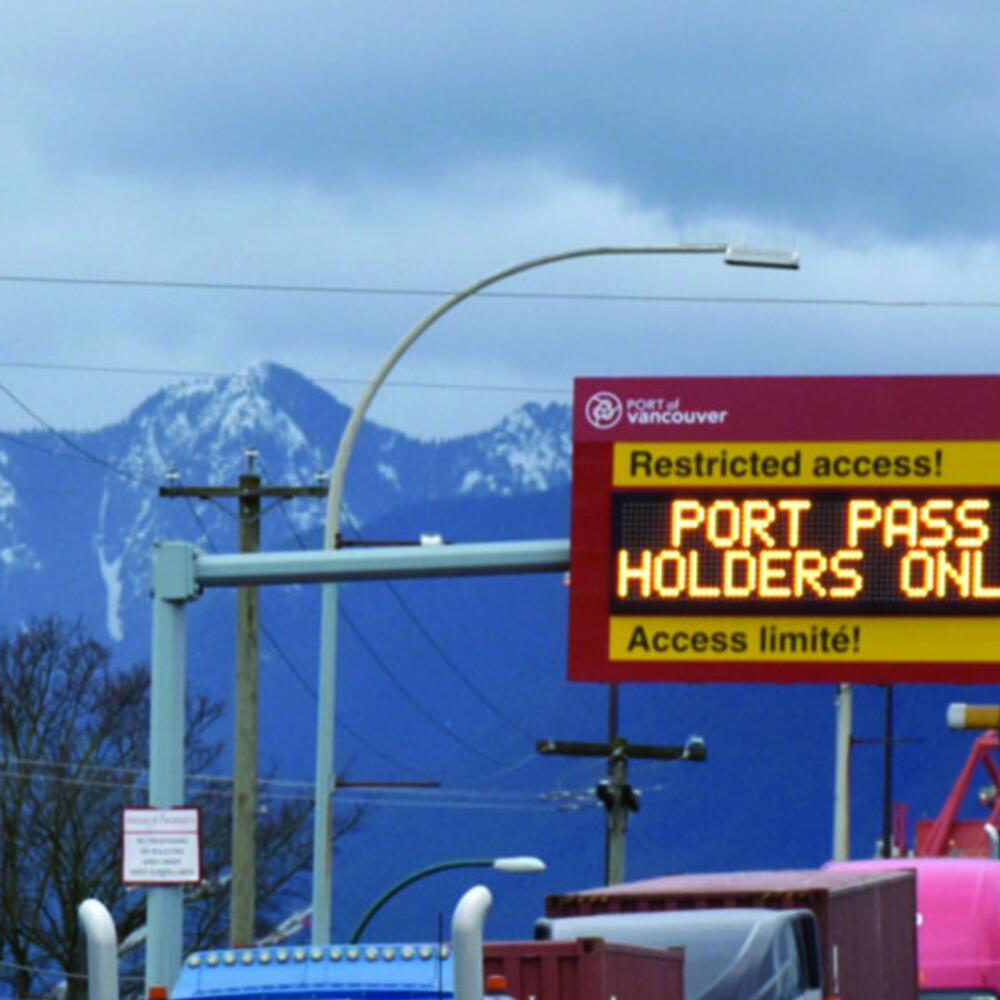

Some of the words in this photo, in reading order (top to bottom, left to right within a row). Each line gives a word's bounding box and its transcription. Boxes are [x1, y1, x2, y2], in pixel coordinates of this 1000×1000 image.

[626, 397, 664, 410] PORT
[626, 409, 728, 425] vancouver
[629, 449, 801, 478] Restricted
[812, 450, 943, 478] access!
[671, 498, 812, 549] PORT
[847, 498, 991, 549] PASS
[616, 549, 864, 599] HOLDERS
[626, 625, 748, 653] Access
[759, 624, 861, 652] limité!
